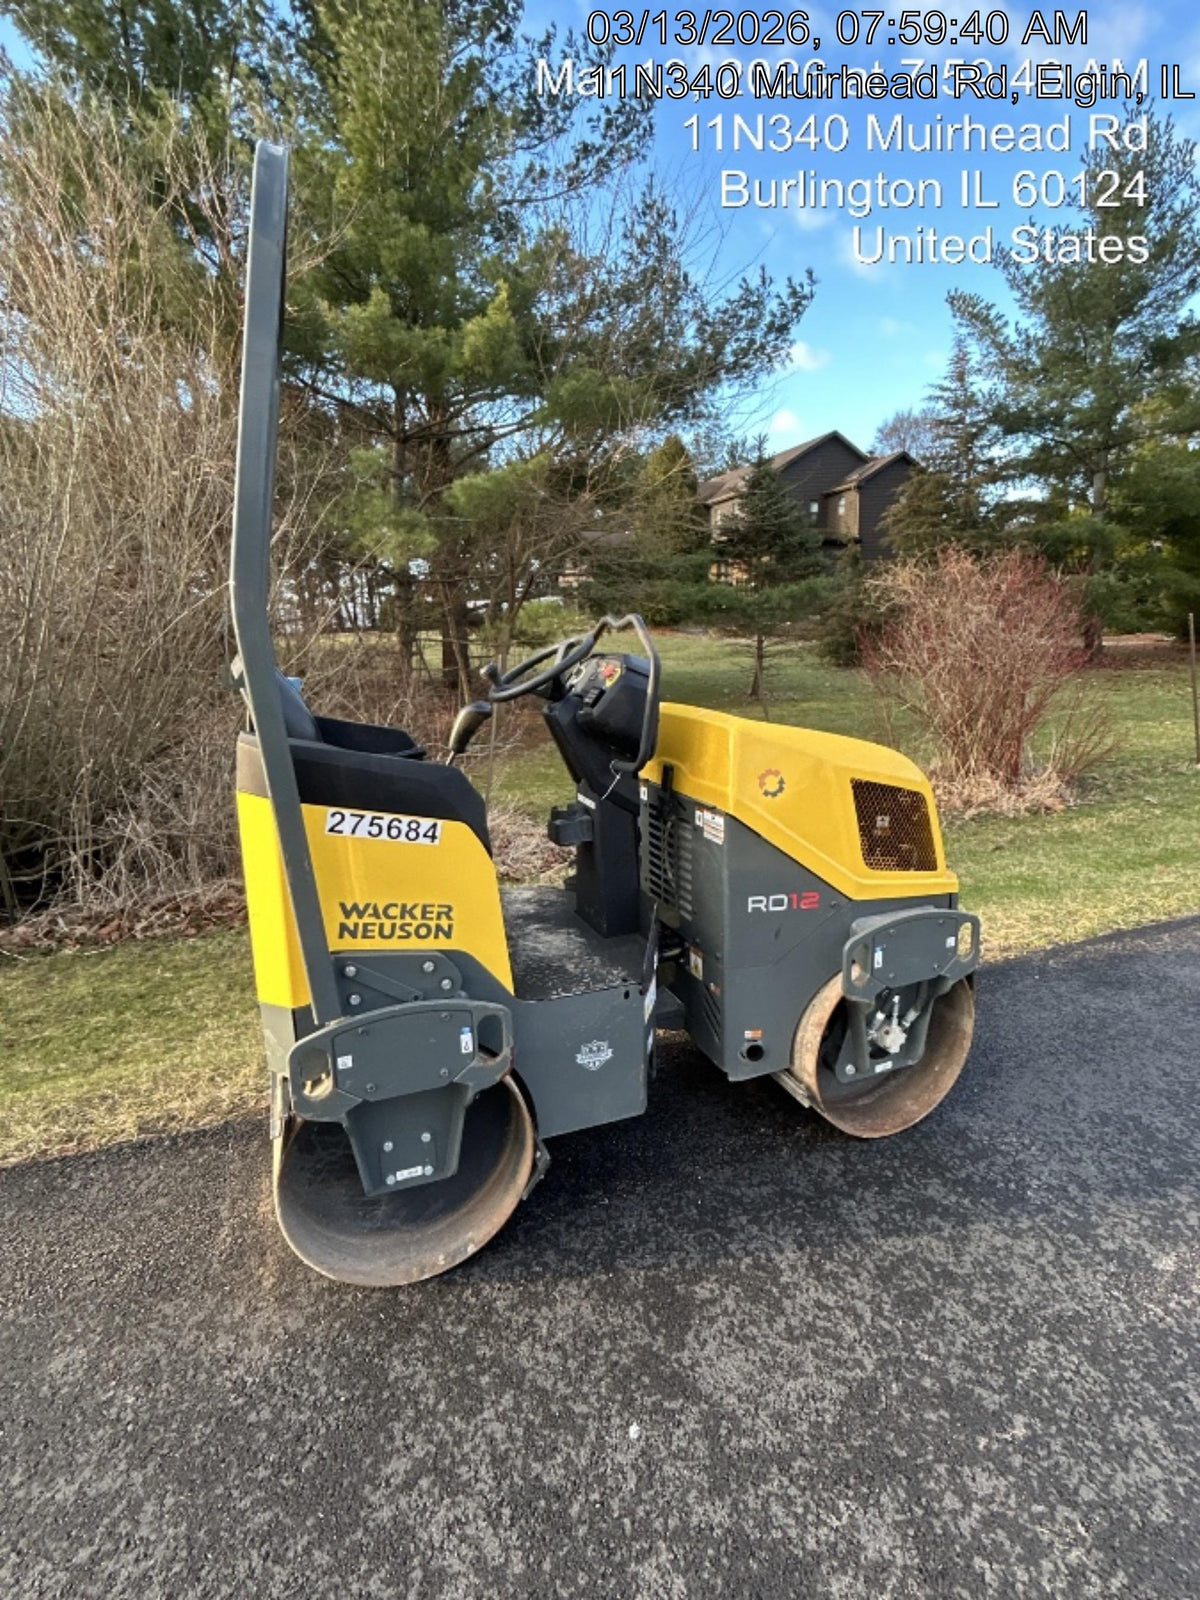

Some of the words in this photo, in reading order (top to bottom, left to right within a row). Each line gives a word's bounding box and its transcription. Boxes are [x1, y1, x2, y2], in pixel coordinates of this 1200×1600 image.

[327, 811, 439, 843] 275684
[339, 902, 454, 921] WACKER
[747, 891, 821, 913] RD12
[338, 922, 454, 939] NEUSON
